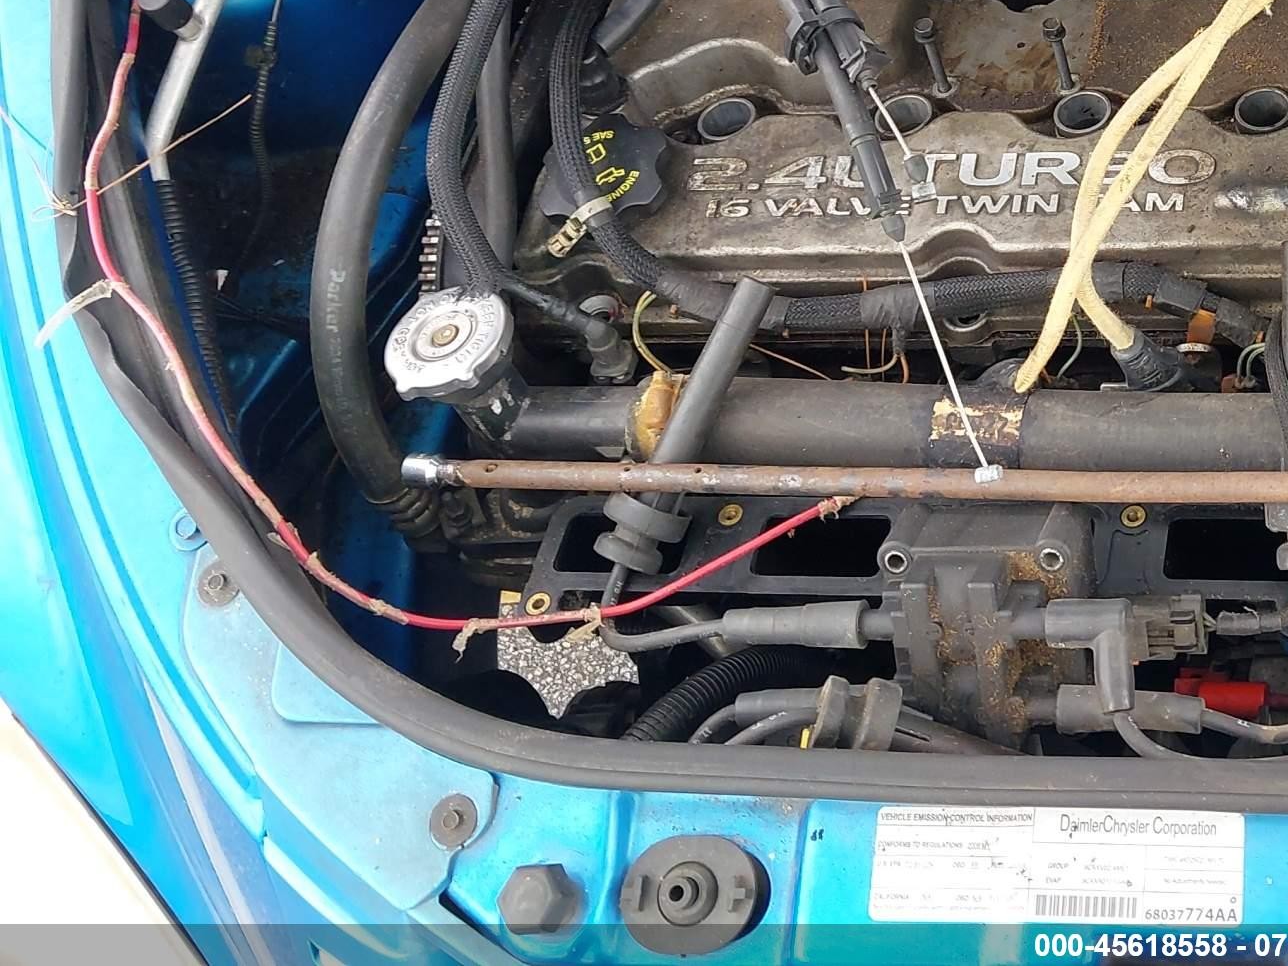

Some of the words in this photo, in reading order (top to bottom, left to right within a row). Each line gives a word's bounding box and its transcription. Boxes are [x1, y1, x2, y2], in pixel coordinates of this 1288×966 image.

[591, 130, 616, 142] SAE
[705, 198, 752, 219] 16
[935, 193, 1060, 215] TWIN
[325, 267, 347, 333] Parker
[881, 813, 912, 822] VEHICLE
[913, 813, 948, 823] EMISSION
[986, 813, 1033, 823] INFORMATION
[1060, 813, 1150, 837] DaimlerChrysler
[1152, 816, 1217, 838] Corporation
[1144, 907, 1238, 923] 68037774AA
